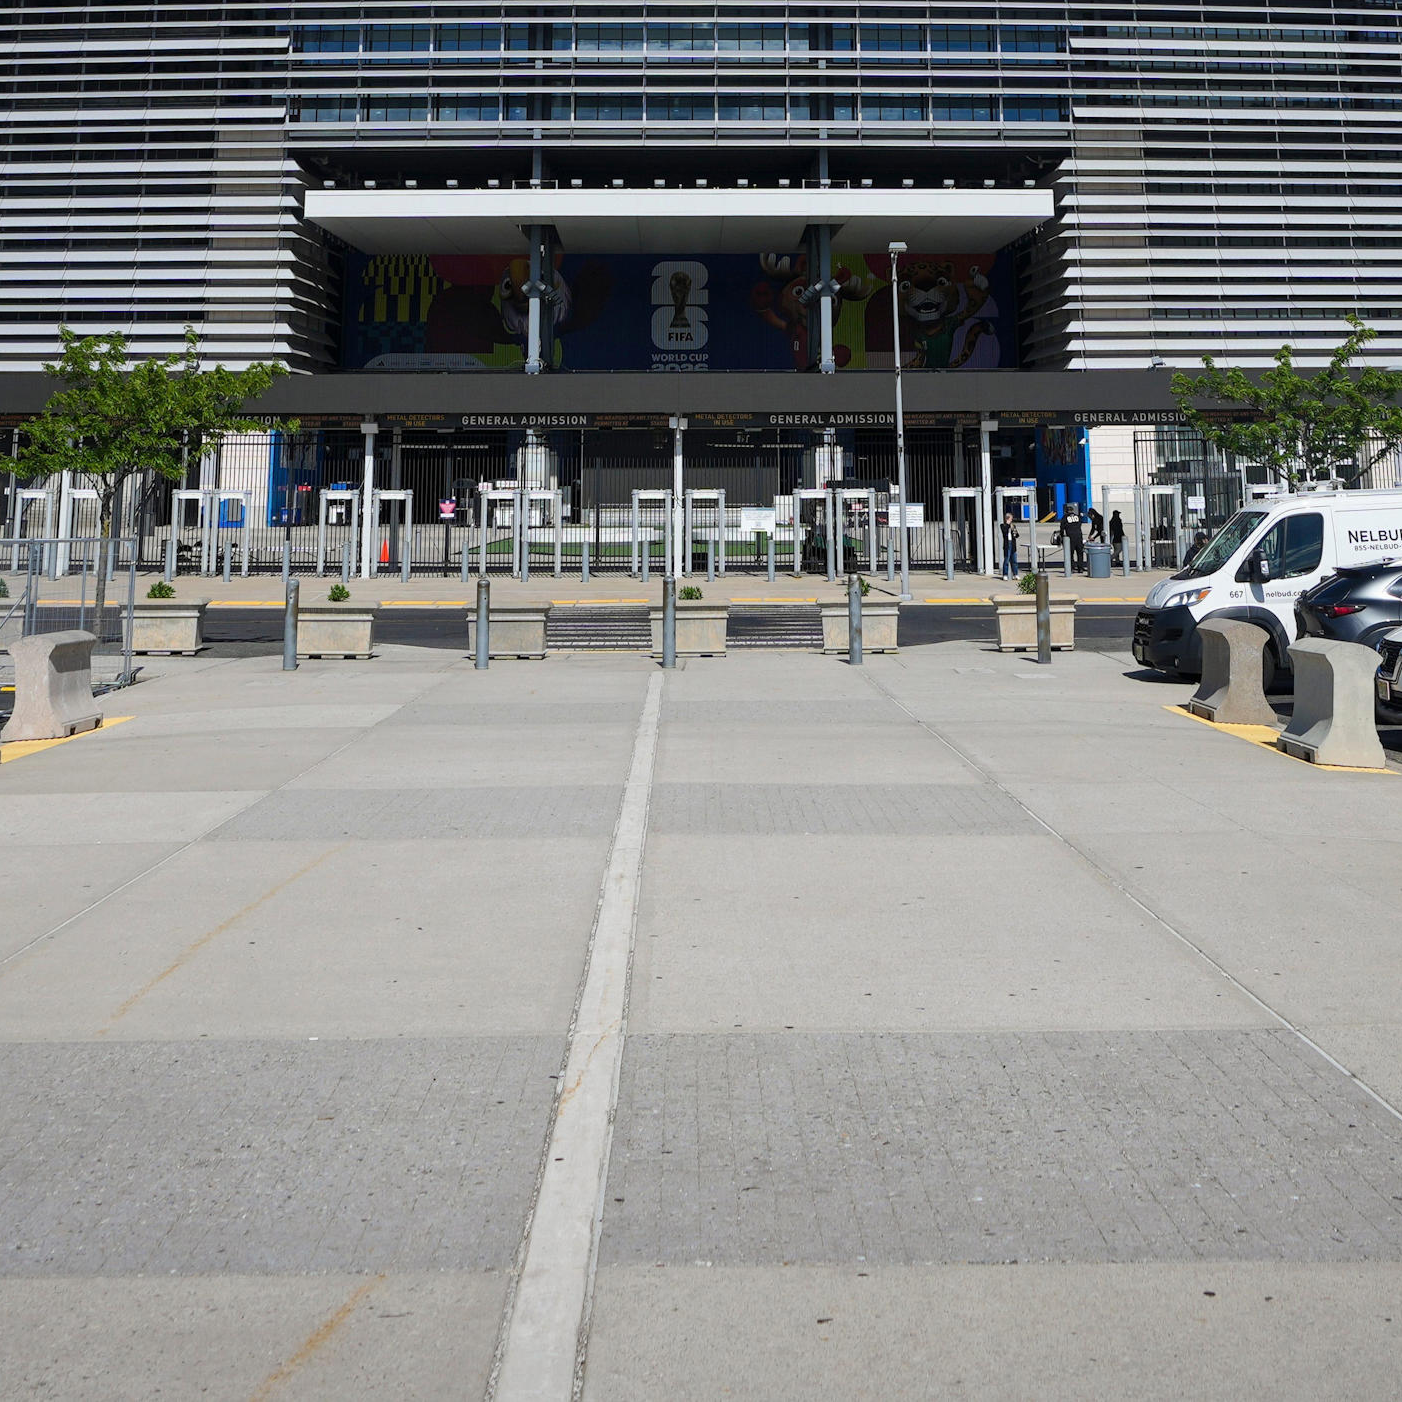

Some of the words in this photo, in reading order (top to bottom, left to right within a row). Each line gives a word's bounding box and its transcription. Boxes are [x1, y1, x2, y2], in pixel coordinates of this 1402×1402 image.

[668, 332, 694, 342] FIFA
[651, 353, 687, 362] WORLD
[689, 353, 709, 362] CUP
[462, 416, 517, 425] GENERAL
[521, 416, 587, 425] ADMISSION
[770, 415, 824, 424] GENERAL
[829, 414, 895, 424] ADMISSION
[1074, 413, 1127, 422] GENERAL
[1132, 412, 1188, 422] ADMISSIO
[1229, 590, 1244, 599] 667
[1265, 589, 1304, 599] nelbud.co
